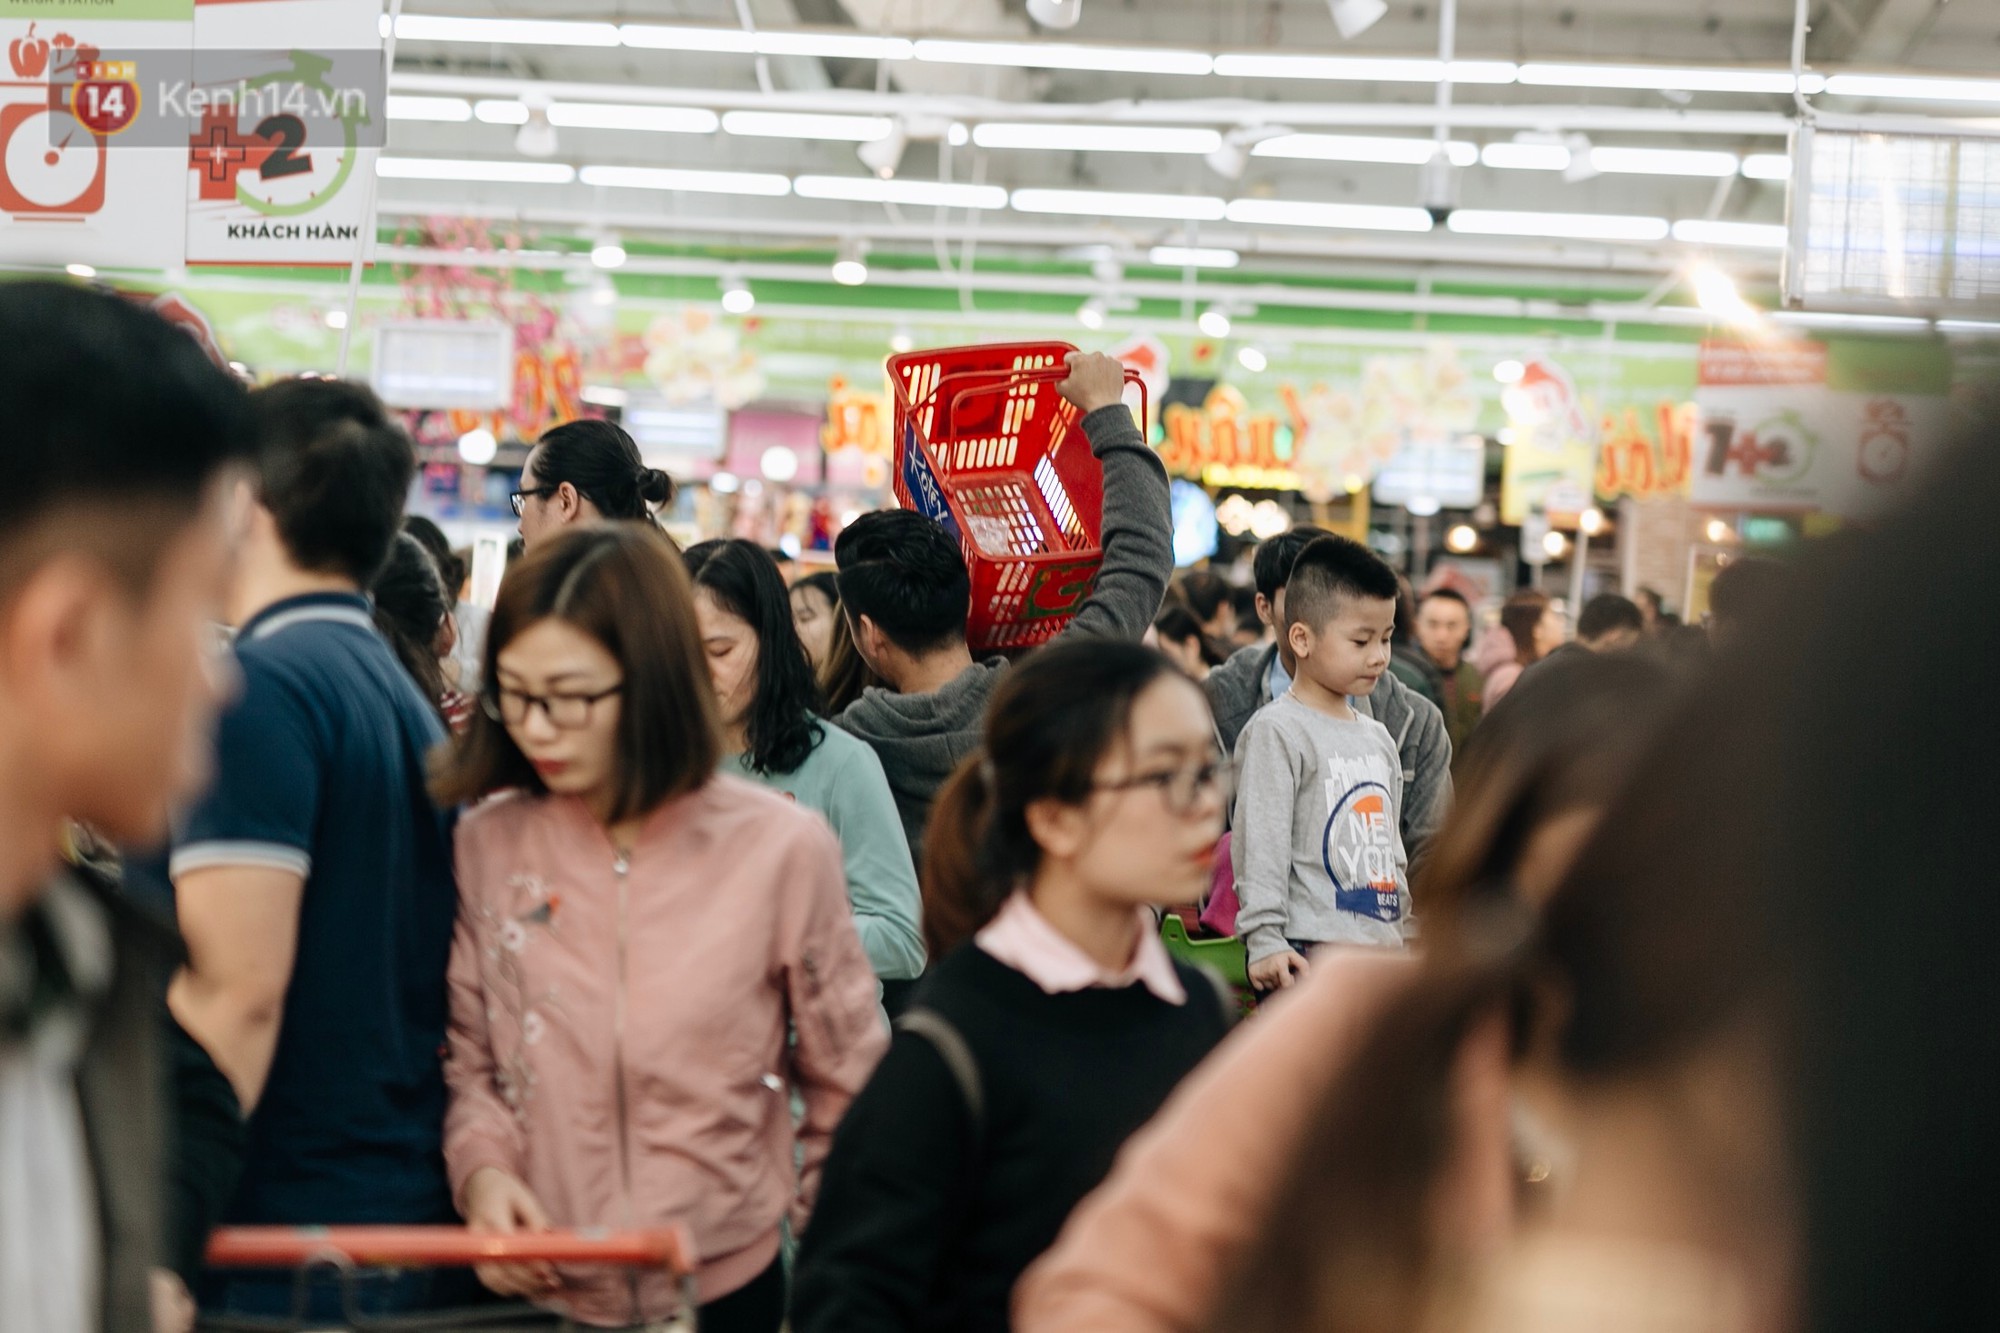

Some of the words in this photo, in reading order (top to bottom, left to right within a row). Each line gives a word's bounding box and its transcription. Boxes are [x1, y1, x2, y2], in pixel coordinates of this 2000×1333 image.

[227, 221, 301, 240] KHÁCH
[1348, 811, 1391, 844] NE
[1338, 845, 1397, 883] YOR
